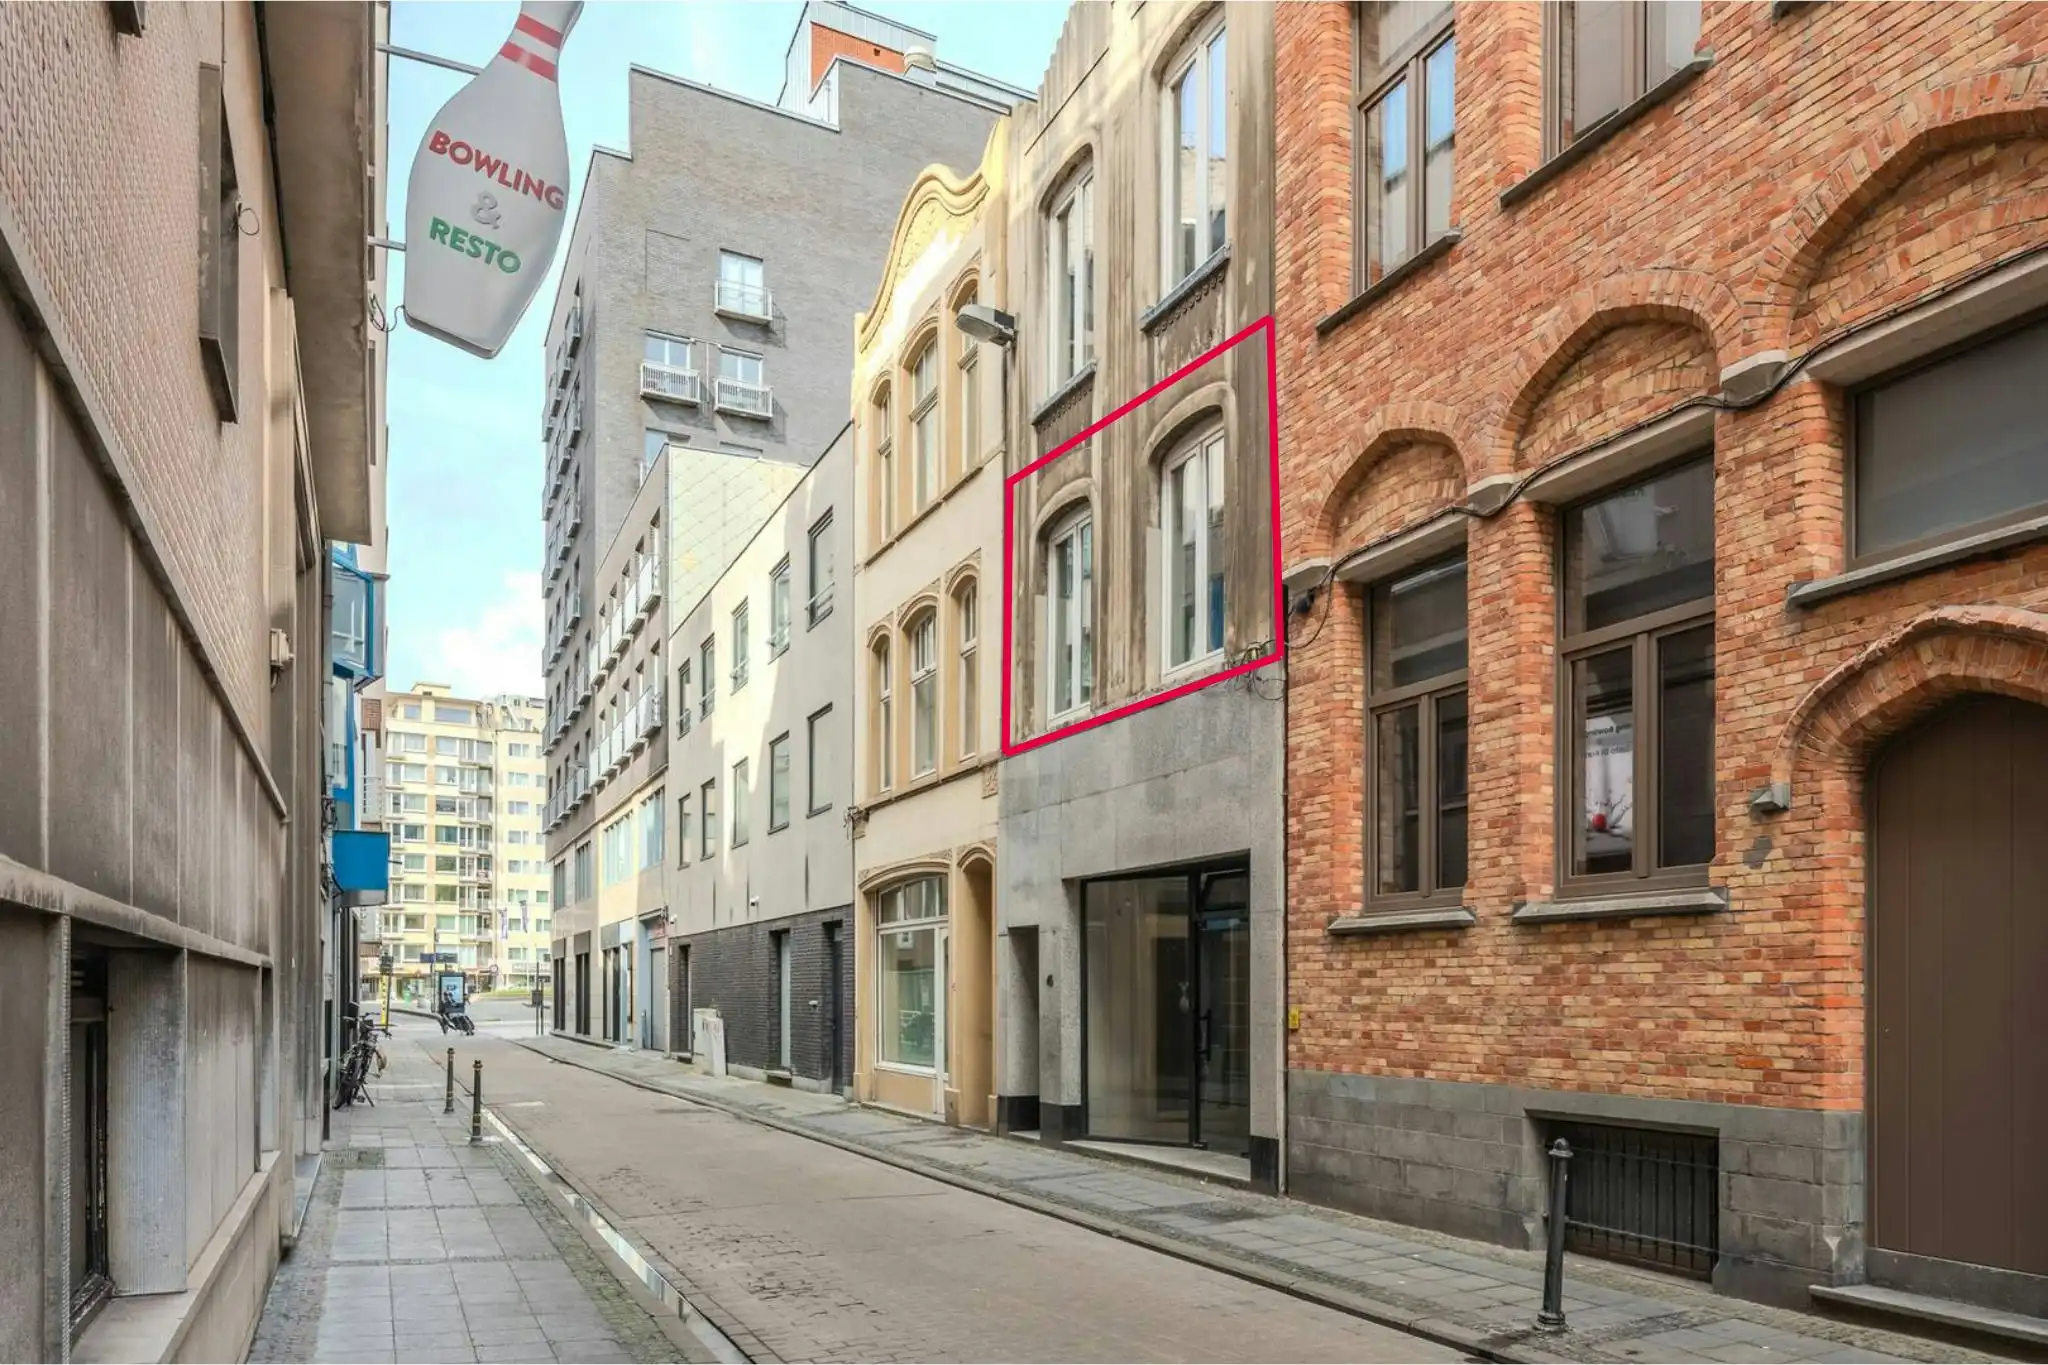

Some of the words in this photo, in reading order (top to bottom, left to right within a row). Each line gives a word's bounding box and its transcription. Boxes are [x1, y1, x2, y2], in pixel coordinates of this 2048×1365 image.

[428, 130, 565, 211] BOWLING
[471, 191, 501, 230] &
[429, 216, 522, 274] RESTO
